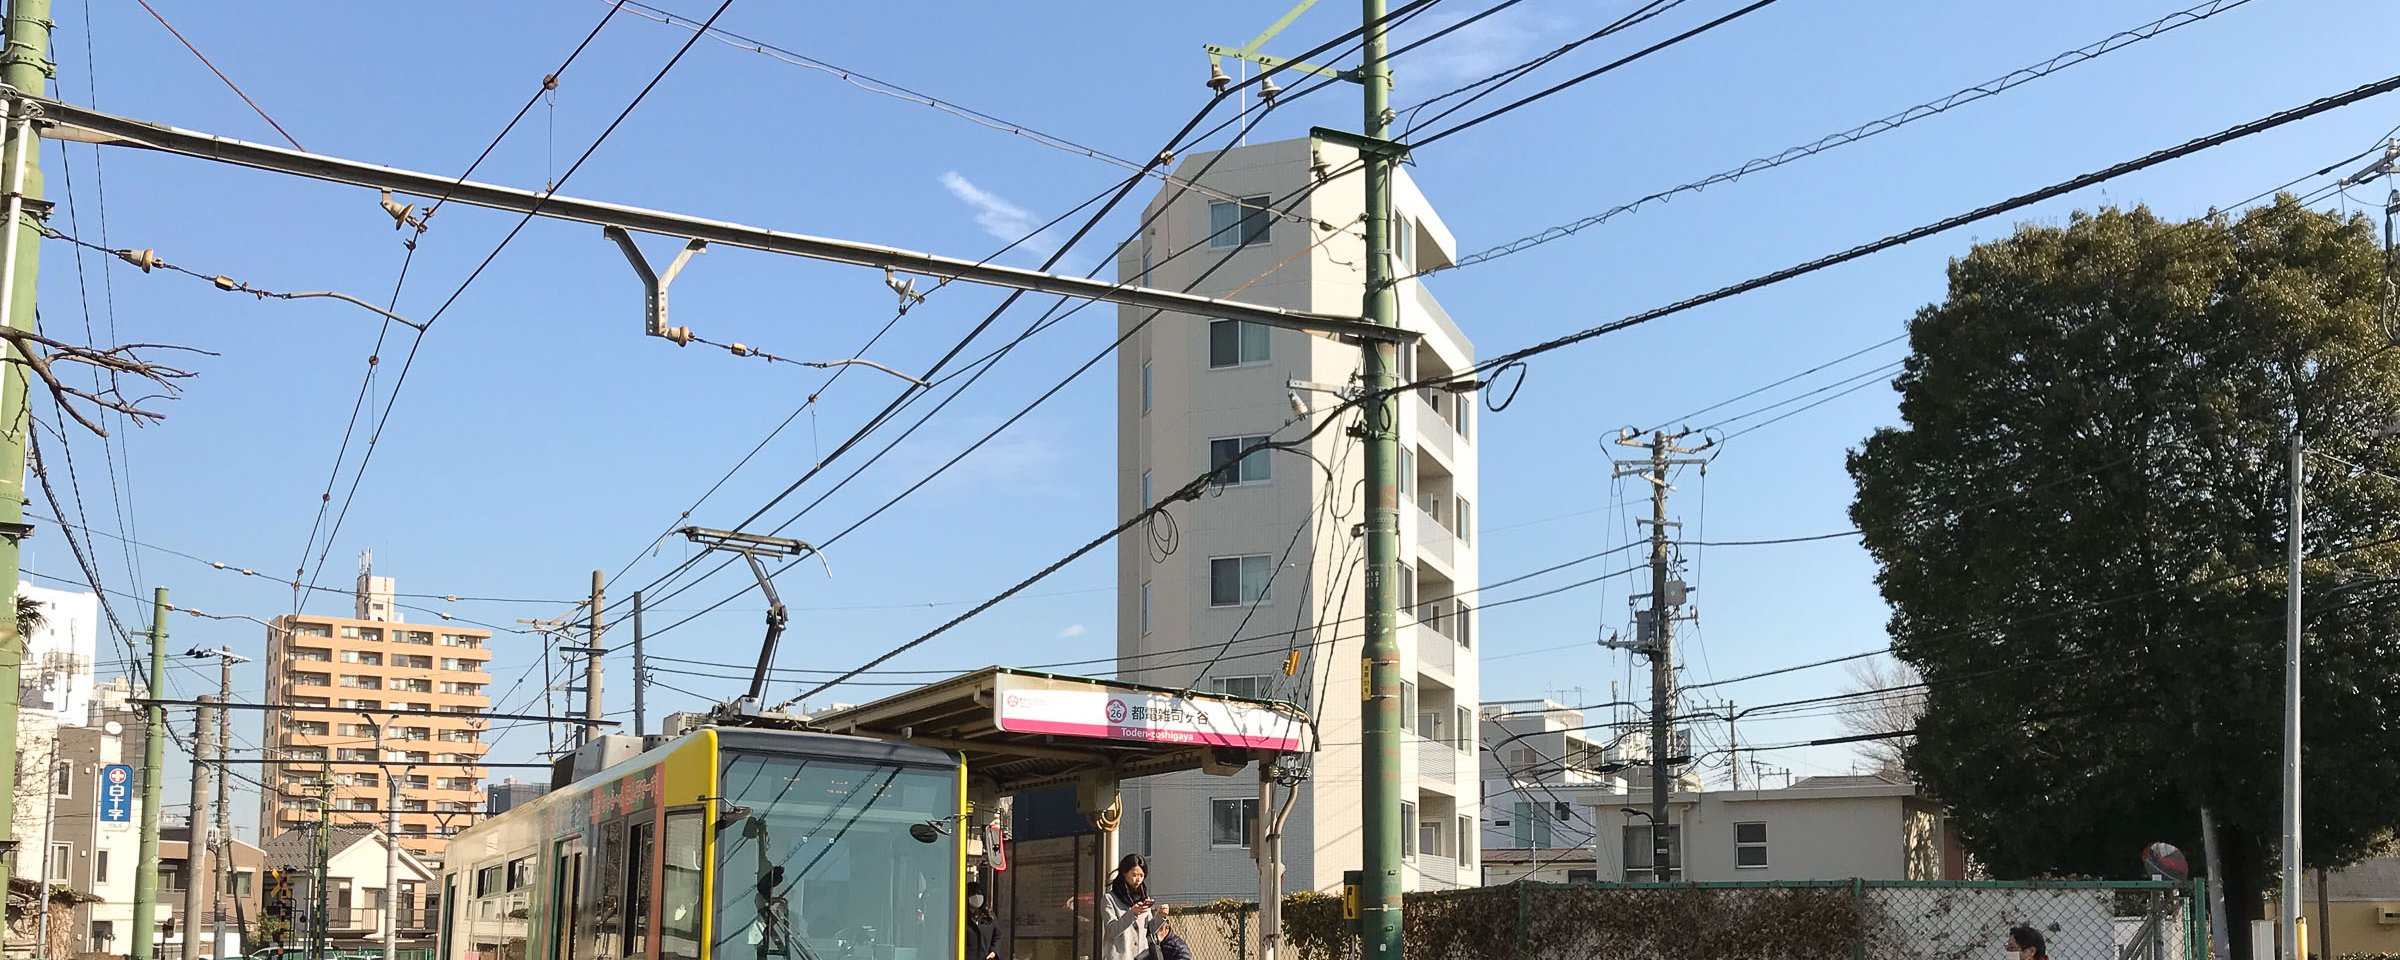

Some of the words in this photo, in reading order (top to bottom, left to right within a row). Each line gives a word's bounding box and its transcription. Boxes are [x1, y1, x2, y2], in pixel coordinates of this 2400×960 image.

[1110, 708, 1121, 718] 26
[1131, 705, 1209, 725] 都電雑司ヶ谷
[1120, 727, 1194, 742] Toden-zoshigaya
[108, 784, 125, 820] 白十字
